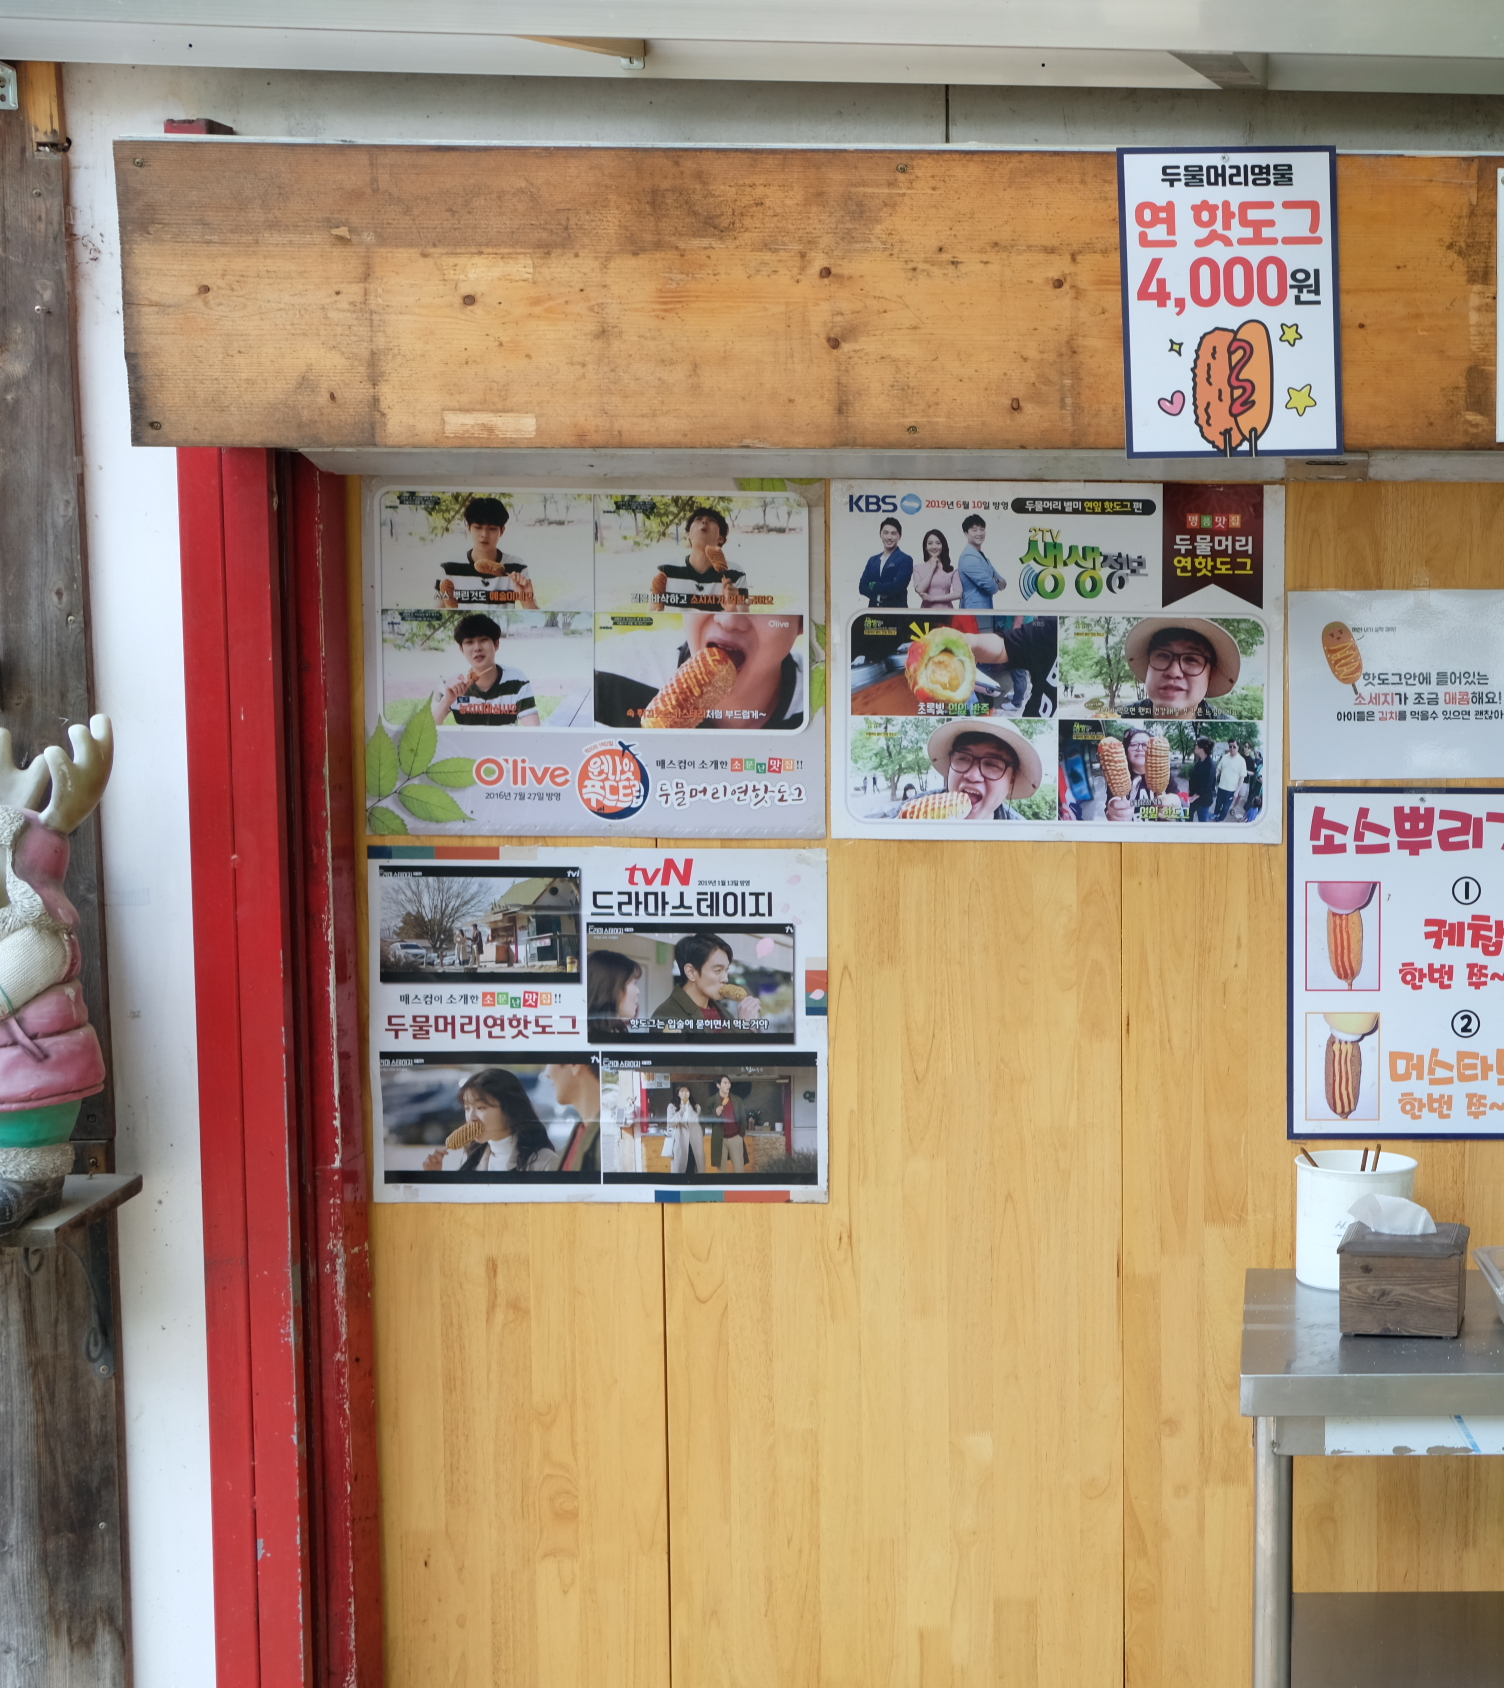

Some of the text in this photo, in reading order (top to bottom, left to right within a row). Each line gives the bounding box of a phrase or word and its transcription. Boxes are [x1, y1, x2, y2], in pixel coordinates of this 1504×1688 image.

[1161, 164, 1293, 187] 두물머리명물
[1135, 199, 1323, 248] 연 핫도그
[1137, 256, 1321, 316] 4,000원
[849, 494, 898, 513] KBS
[925, 499, 1009, 510] 2019년 6월 10일 방영
[1025, 500, 1143, 513] 두물머리 별미 연잎 핫도그 편
[1029, 526, 1061, 542] 2TV
[1174, 535, 1253, 555] 두물머리
[1174, 556, 1254, 576] 연핫도그
[1362, 671, 1490, 687] 핫도그안에 들어있는
[1353, 691, 1502, 706] 소세지가 조금 매콤해요!
[917, 702, 945, 715] 초록빛
[1336, 711, 1376, 722] 아이들은
[1378, 711, 1408, 721] 김치를
[1410, 710, 1439, 721] 먹을수
[1441, 710, 1471, 721] 있으면
[656, 759, 696, 770] 매스컴이
[698, 759, 729, 770] 소개한
[485, 791, 561, 802] 2016년 7월 27일 방영
[625, 858, 694, 887] tvN
[591, 891, 773, 917] 드라마스테이지
[1398, 962, 1454, 990] 한번
[400, 994, 443, 1005] 매스컴이
[446, 994, 479, 1005] 소개한
[385, 1014, 580, 1040] 두물머리연핫도그
[630, 1019, 666, 1030] 핫도그는
[667, 1019, 694, 1030] 입술에
[1398, 1092, 1453, 1120] 한번
